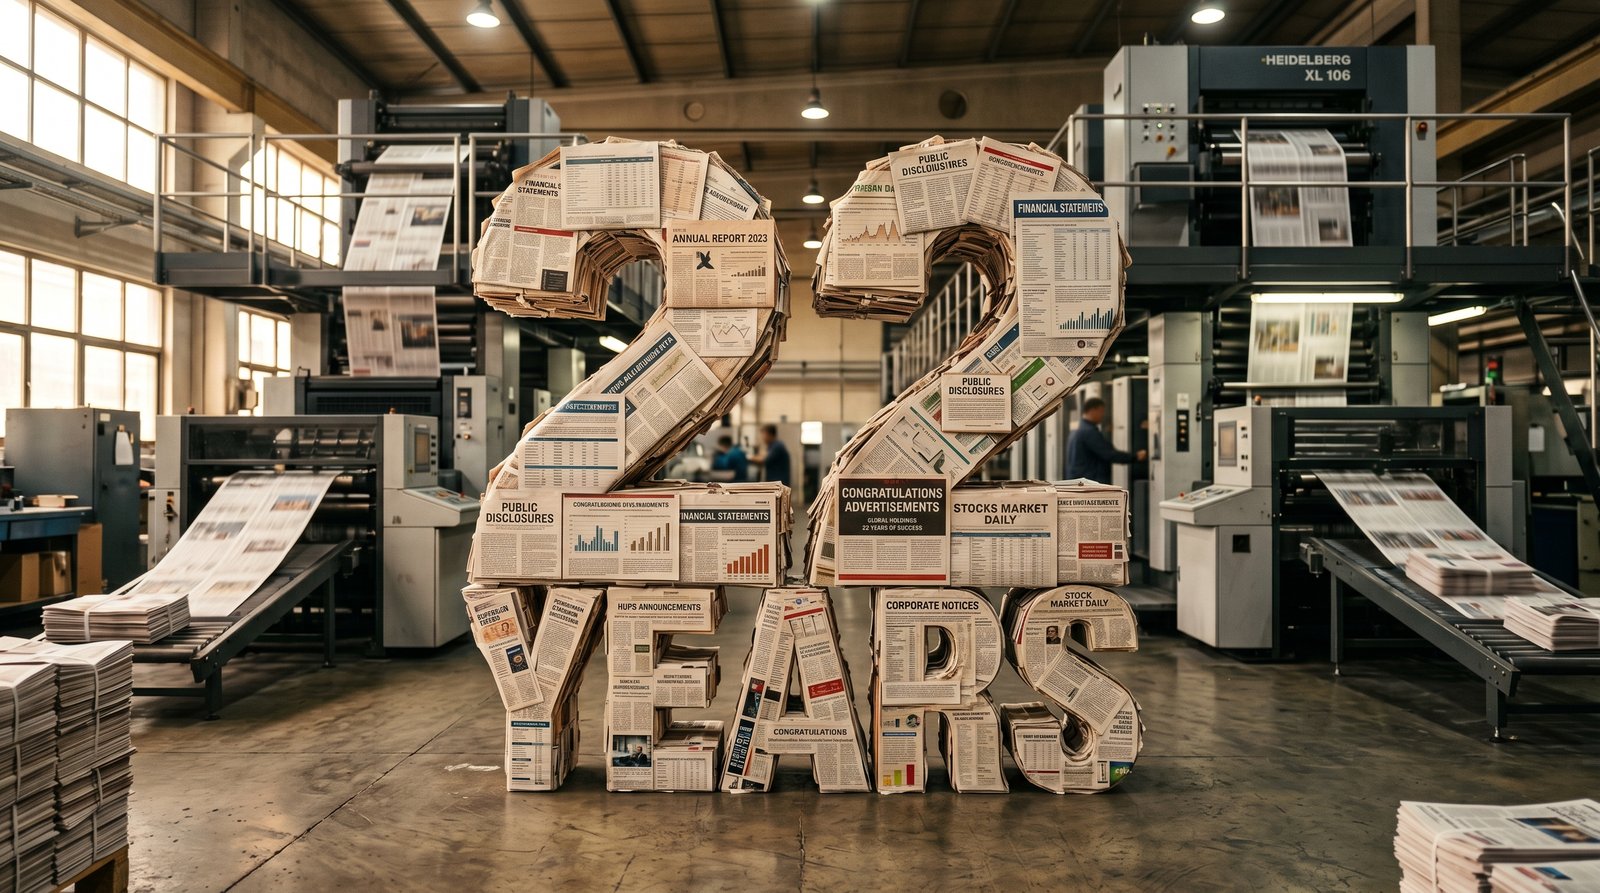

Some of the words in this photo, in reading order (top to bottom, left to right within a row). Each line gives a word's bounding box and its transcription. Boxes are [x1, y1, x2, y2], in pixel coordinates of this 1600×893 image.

[1266, 55, 1351, 66] HEIDELBERG
[1304, 69, 1323, 81] XL
[1326, 69, 1351, 81] 106
[918, 152, 949, 164] PUBLIC
[525, 179, 558, 189] FINANCIAL
[517, 186, 559, 197] STATEMENTS
[1018, 203, 1059, 213] FINANCIAL
[672, 234, 710, 243] ANNUAL
[712, 234, 746, 243] REPORT
[748, 234, 768, 243] 2023
[962, 377, 991, 386] PUBLIC
[948, 387, 1005, 395] DISCLOSURES
[842, 487, 943, 498] CONGRATULATIONS
[502, 502, 538, 512] PUBLIC
[844, 501, 940, 513] ADVERTISEMENTS
[953, 503, 998, 514] STOCKS
[1000, 503, 1049, 513] MARKET
[486, 513, 554, 523] DISCLOSURES
[680, 512, 716, 521] INANCIAL
[984, 515, 1017, 525] DAILY
[1064, 591, 1092, 599] STOCK
[617, 603, 637, 611] HUPS
[639, 603, 701, 611] ANNOUNCEMENTS
[886, 601, 939, 610] CORPORATE
[941, 601, 979, 610] NOTICES
[1050, 600, 1083, 608] MARKET
[1085, 599, 1109, 607] DAILY
